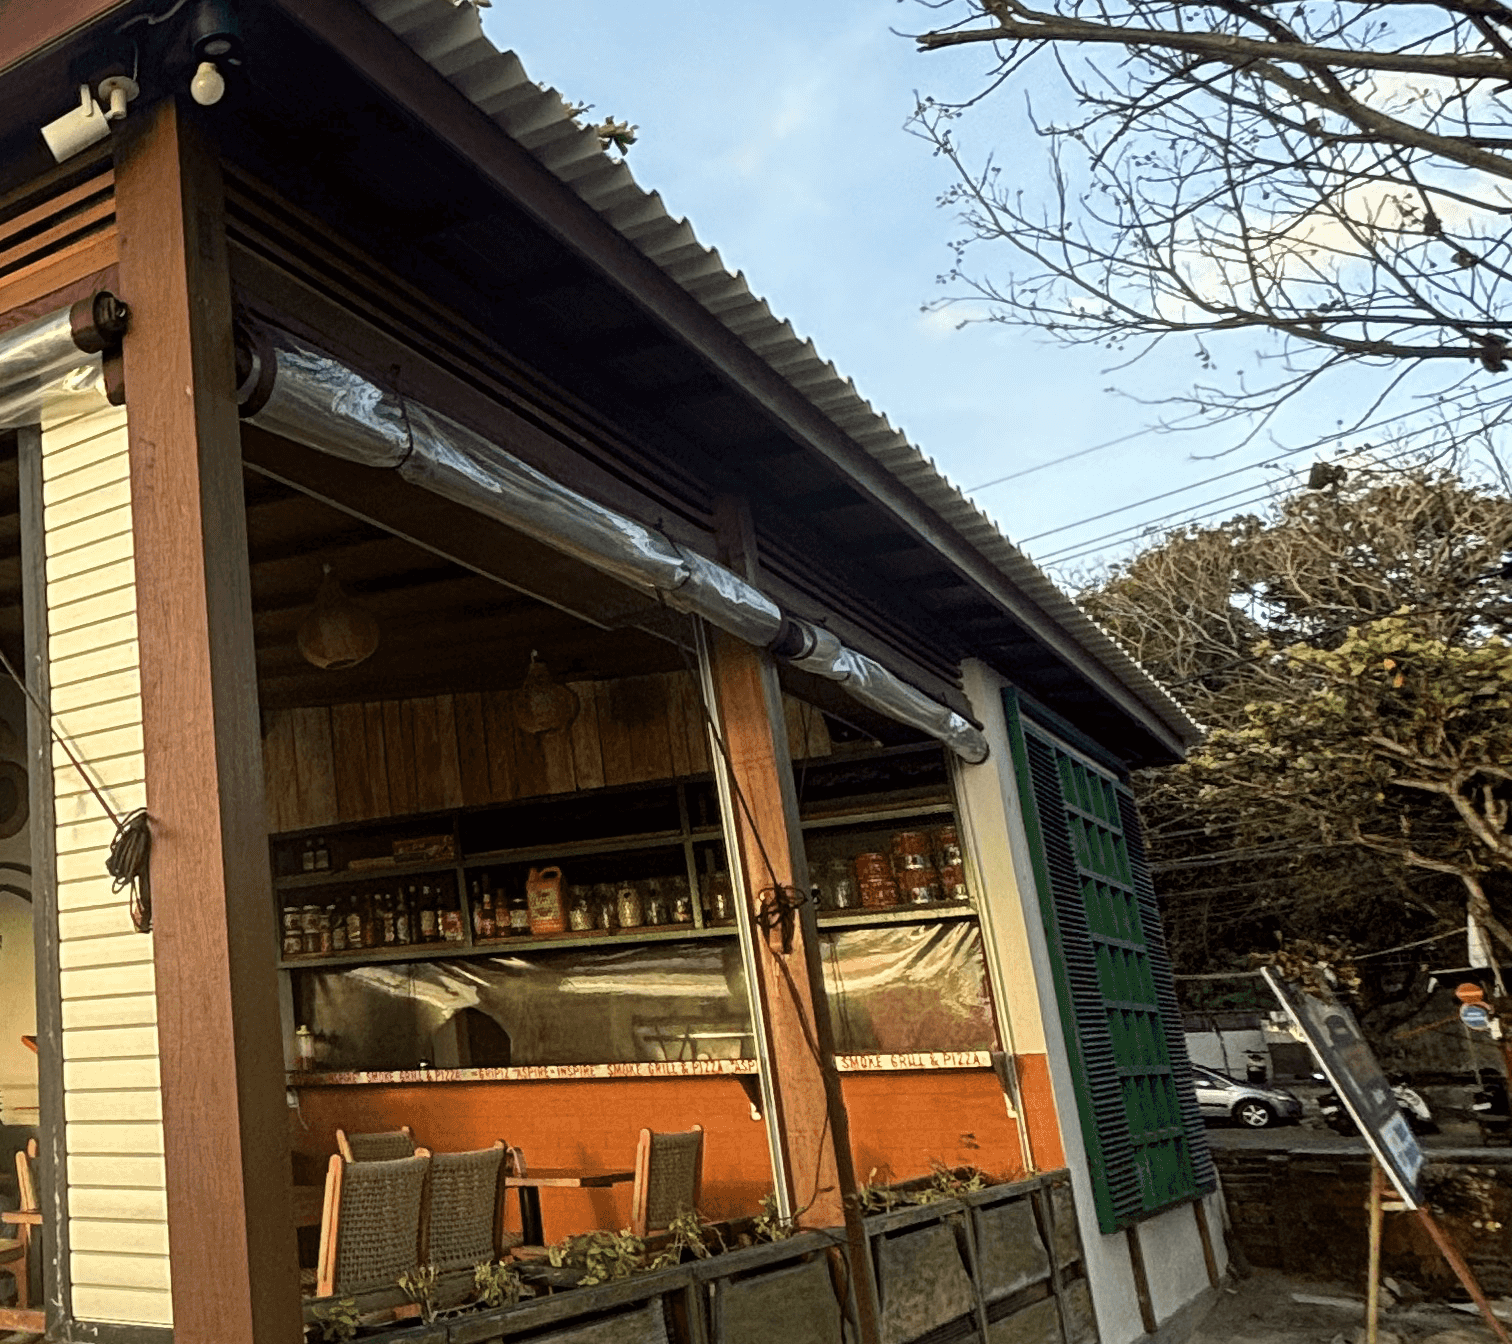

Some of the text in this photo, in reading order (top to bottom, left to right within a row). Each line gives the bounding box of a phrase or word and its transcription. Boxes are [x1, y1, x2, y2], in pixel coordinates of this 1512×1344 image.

[607, 1063, 641, 1077] SMOKE
[648, 1062, 678, 1075] GRILL
[693, 1060, 723, 1073] PIZZA
[841, 1052, 981, 1069] SMOKE GRILL & PIZZA
